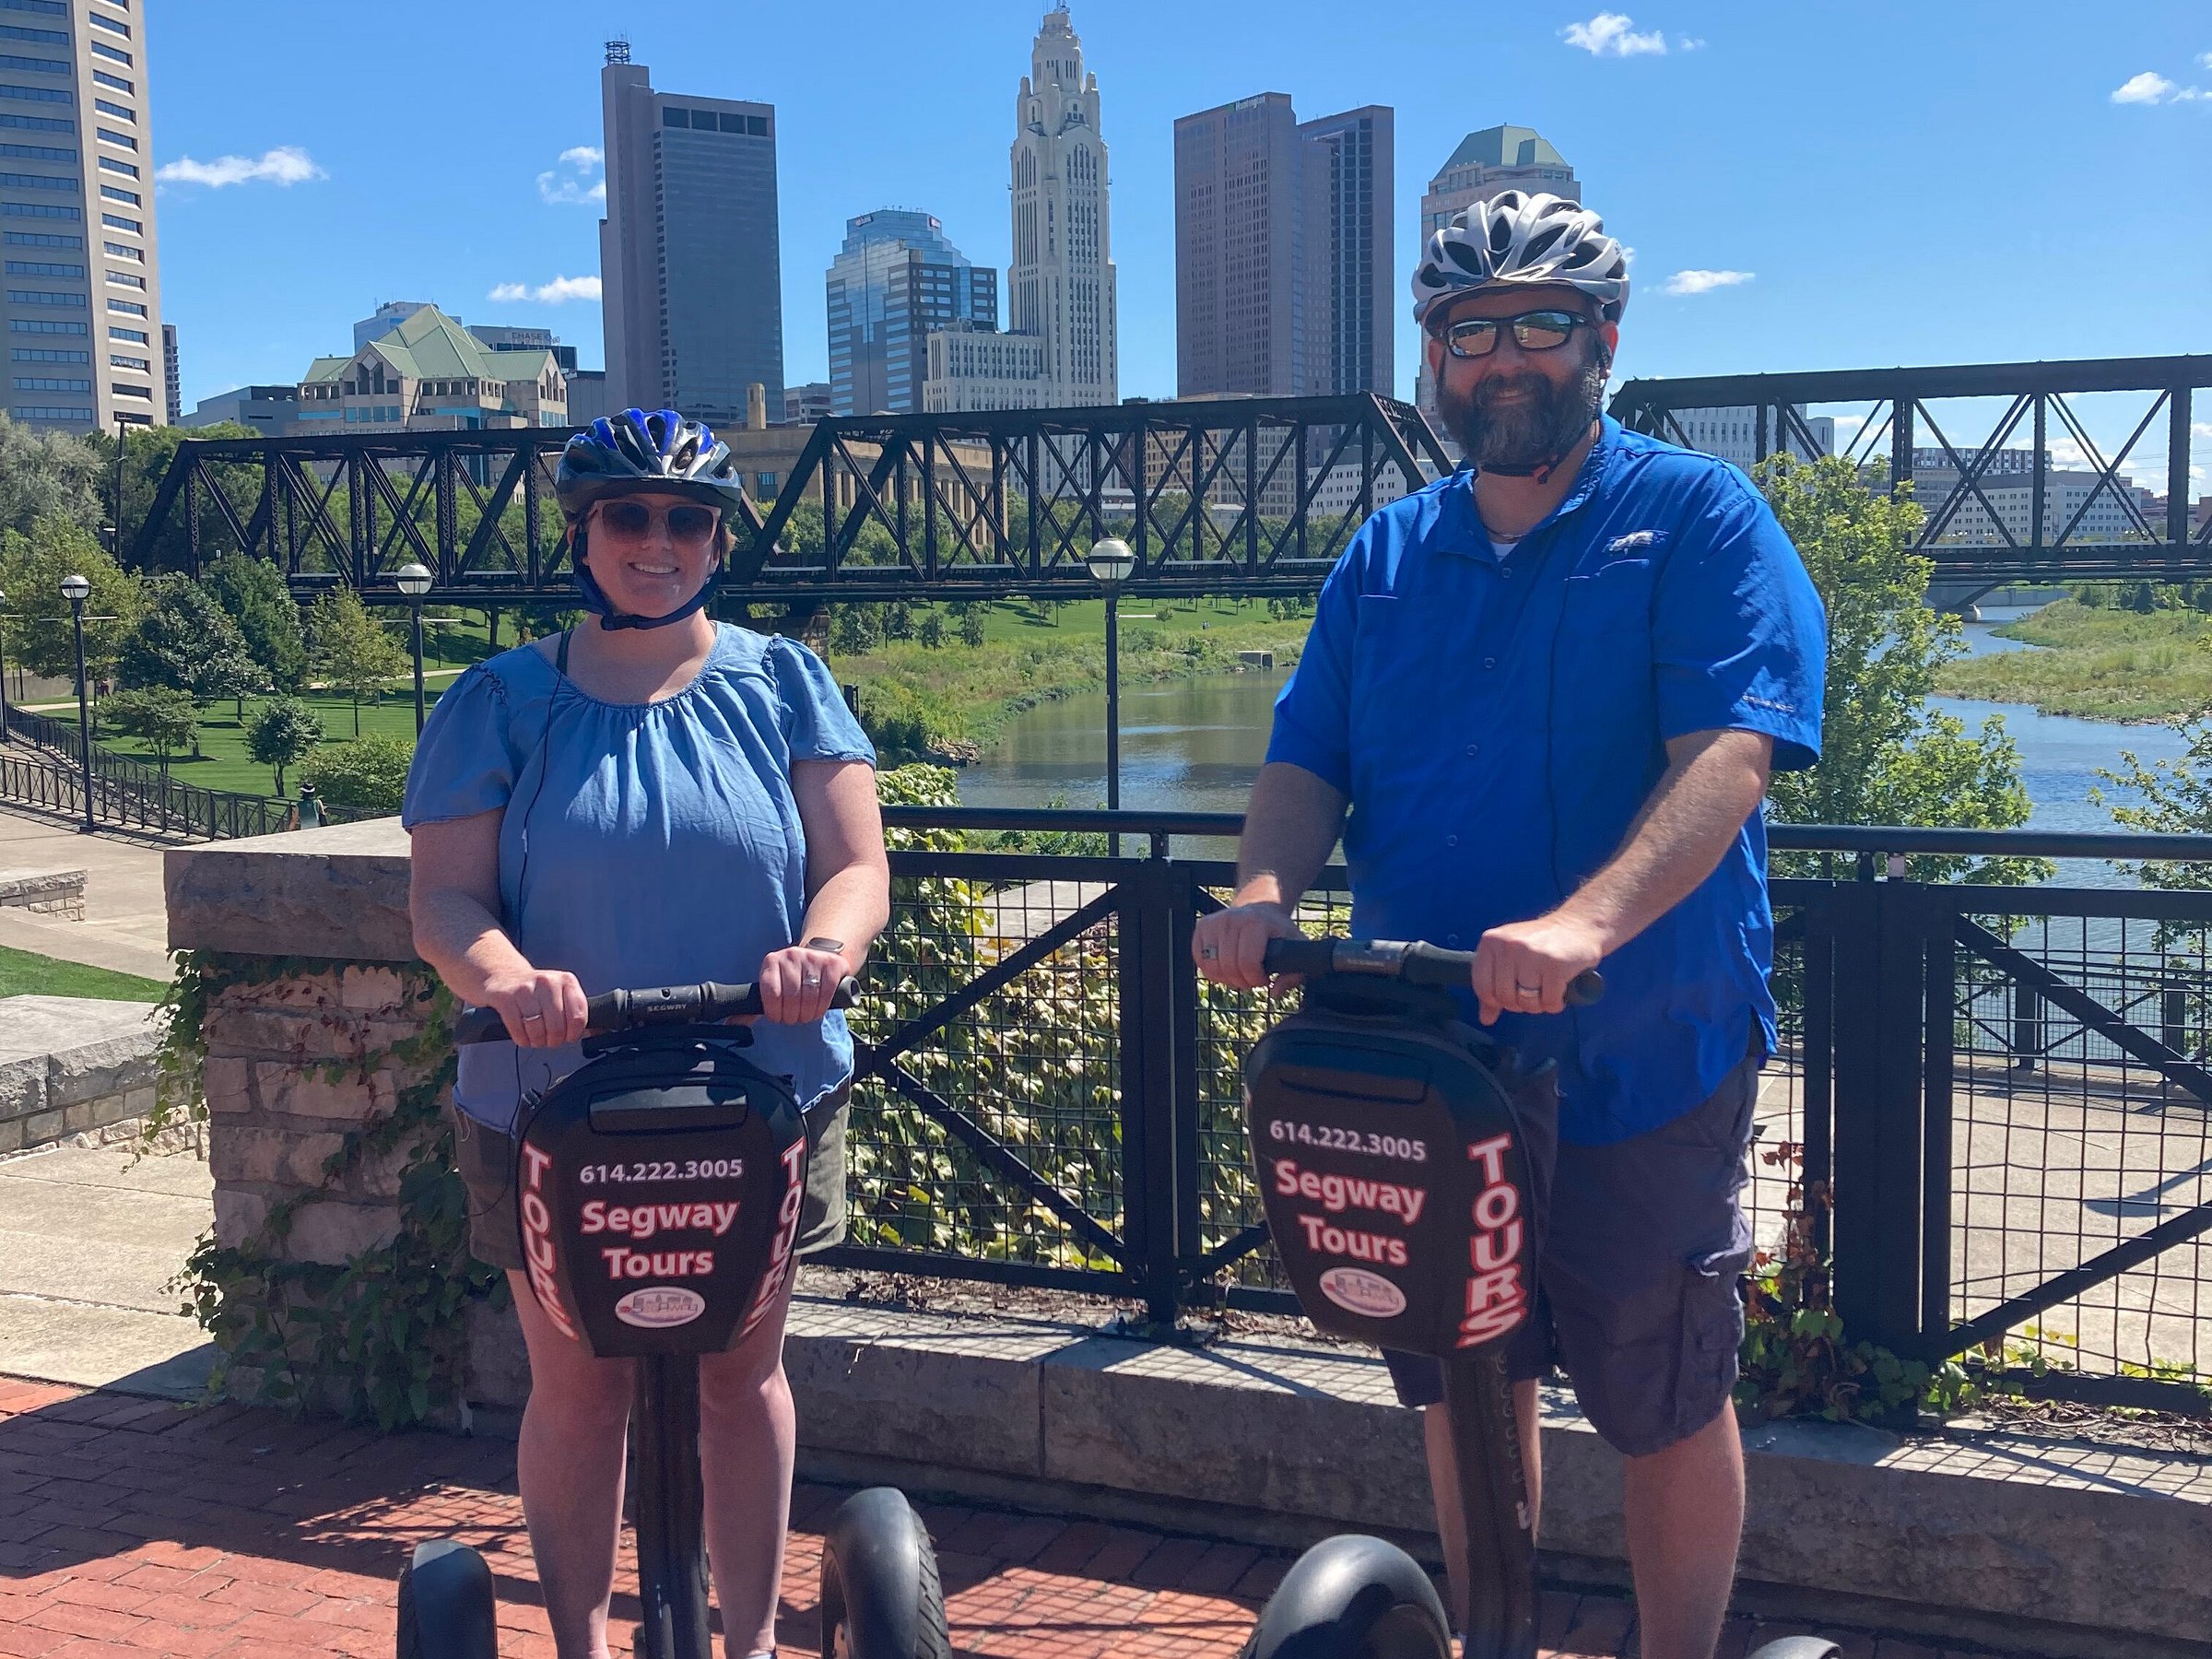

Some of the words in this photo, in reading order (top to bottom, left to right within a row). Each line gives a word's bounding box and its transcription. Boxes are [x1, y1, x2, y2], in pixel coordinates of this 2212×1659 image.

[512, 332, 543, 340] CHASE
[647, 1003, 688, 1012] SEGWAY
[1269, 1119, 1427, 1161] 614.222.3005
[579, 1159, 743, 1184] 614.222.3005
[1275, 1159, 1426, 1224] Segway
[581, 1200, 740, 1239] Segway
[1298, 1213, 1409, 1266] Tours
[1455, 1132, 1527, 1348] TOURS
[602, 1246, 715, 1279] Tours
